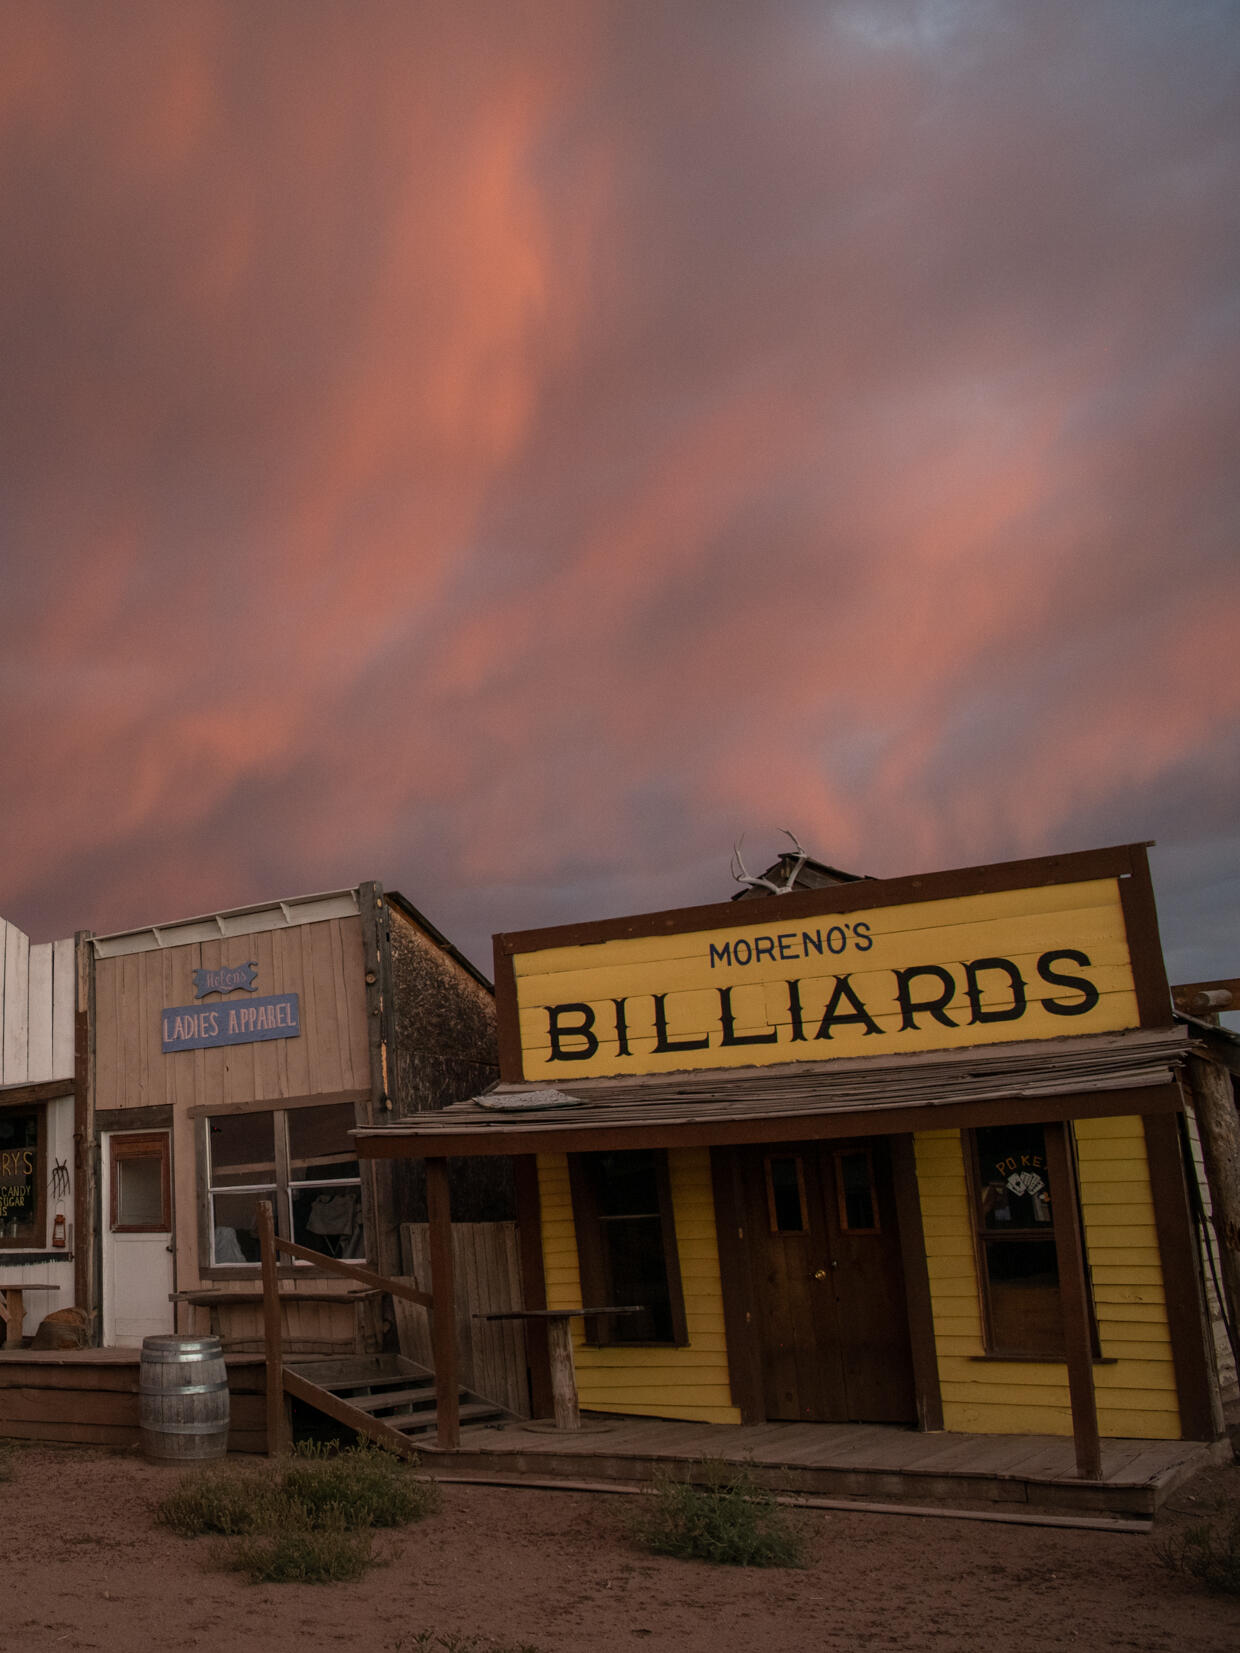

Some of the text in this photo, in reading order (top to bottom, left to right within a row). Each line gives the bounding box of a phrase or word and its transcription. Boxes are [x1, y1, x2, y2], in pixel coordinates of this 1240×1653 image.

[709, 921, 874, 969] MORENO'S
[163, 1003, 297, 1042] LADIES APPAREL
[544, 948, 1100, 1063] BILLIARDS
[995, 1155, 1047, 1176] POKE
[1, 1185, 31, 1197] CANDY
